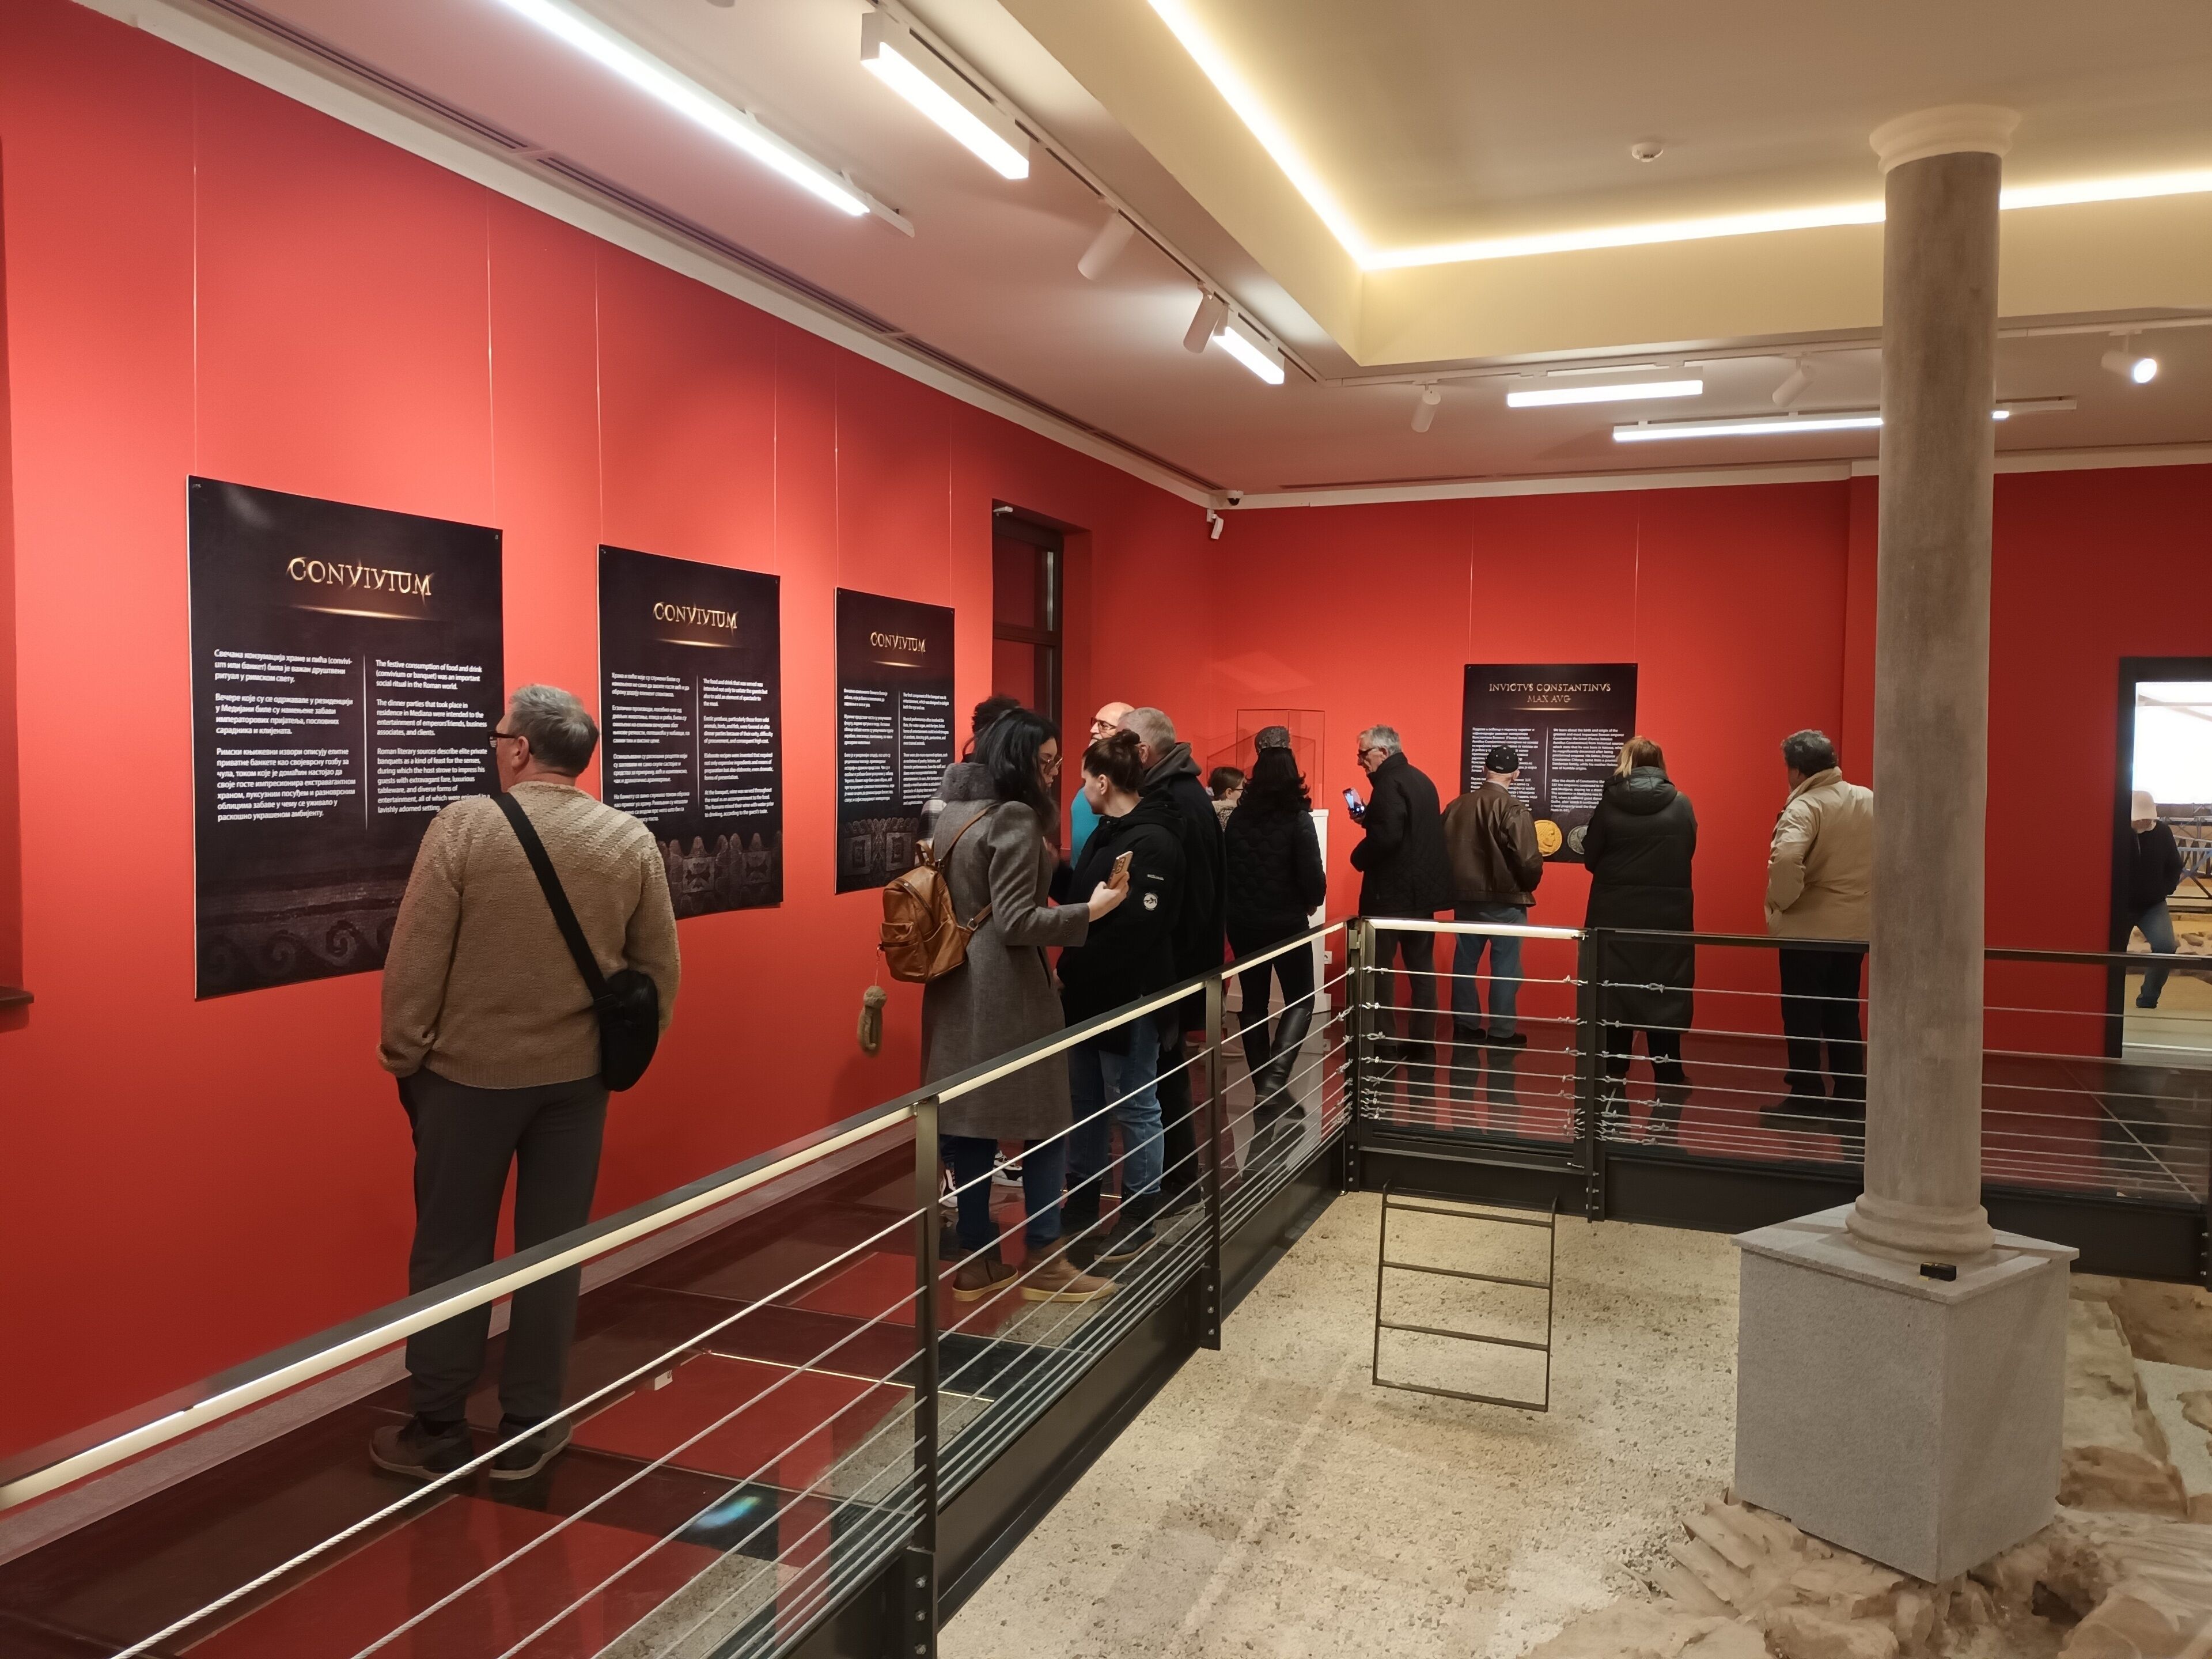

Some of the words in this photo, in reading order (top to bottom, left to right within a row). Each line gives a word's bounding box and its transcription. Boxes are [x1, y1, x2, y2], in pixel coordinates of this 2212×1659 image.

[287, 557, 435, 600] CONVIVIUM
[653, 602, 738, 630] CONVIVIUM
[870, 632, 926, 656] CONVIVIUM
[413, 672, 437, 680] banquet)
[1536, 683, 1611, 693] CONSTANTINVS
[1527, 695, 1548, 703] MAX
[1551, 695, 1571, 703] AVG
[397, 748, 416, 756] literary
[377, 757, 403, 766] banquets
